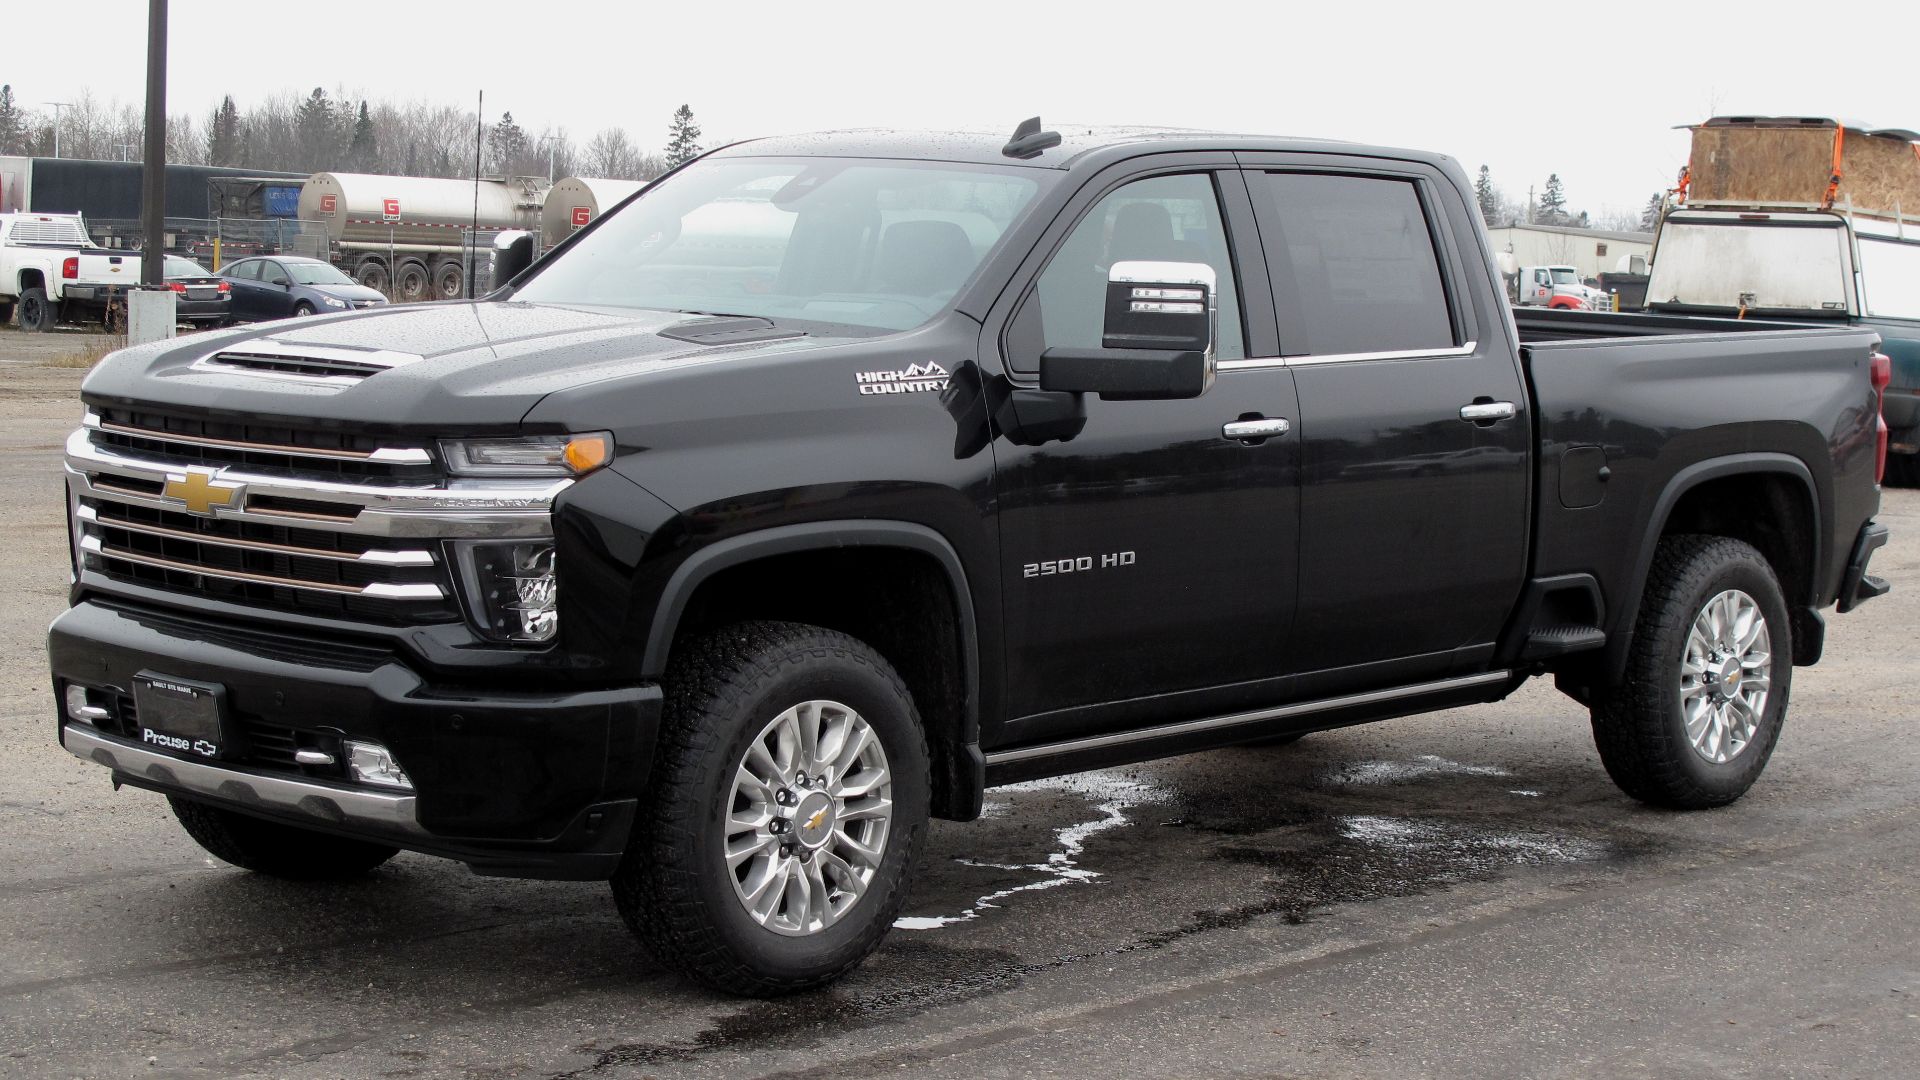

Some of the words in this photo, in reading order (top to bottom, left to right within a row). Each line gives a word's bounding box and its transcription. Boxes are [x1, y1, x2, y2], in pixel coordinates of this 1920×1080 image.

[384, 199, 399, 215] G
[572, 208, 590, 225] G
[855, 370, 905, 383] HIGH
[860, 380, 949, 395] COUNTRY
[1023, 556, 1093, 579] 2500
[1101, 551, 1136, 568] HD
[143, 727, 190, 750] Prouse
